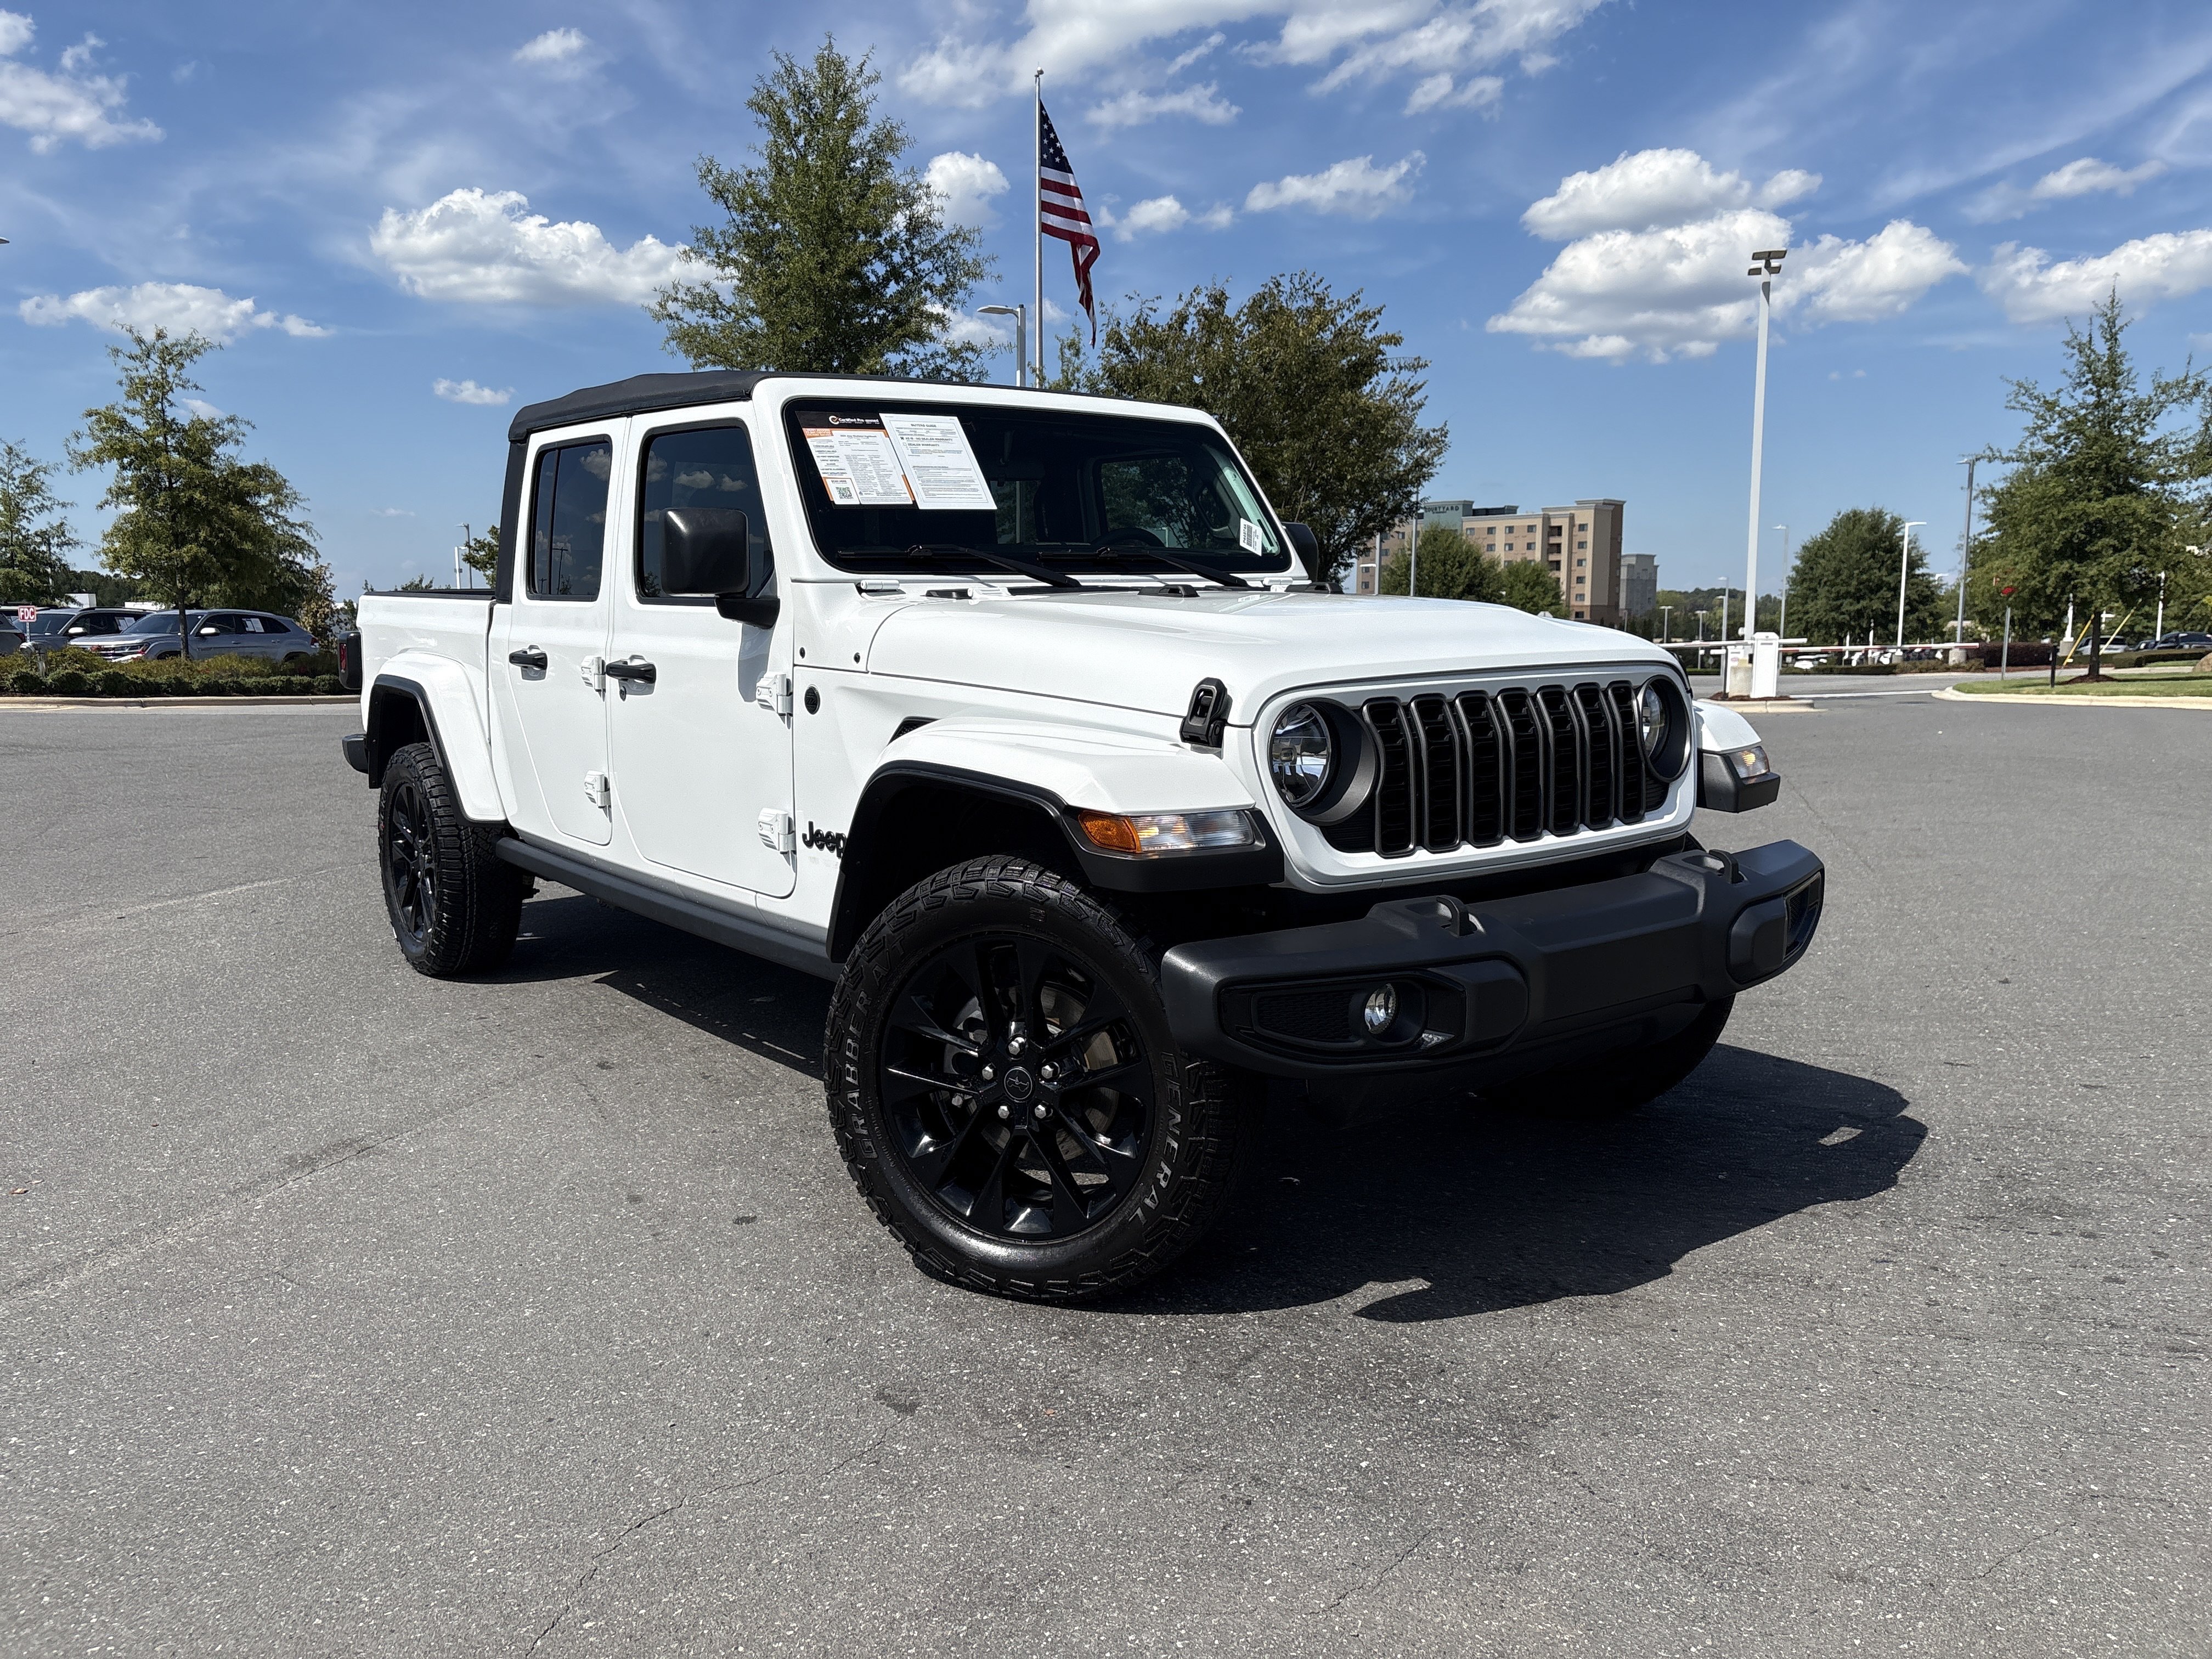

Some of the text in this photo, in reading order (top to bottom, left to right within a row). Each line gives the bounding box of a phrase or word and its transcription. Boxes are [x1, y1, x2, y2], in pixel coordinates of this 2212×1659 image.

[20, 608, 34, 619] FDC
[802, 821, 847, 859] Jeep
[845, 990, 878, 1159] GRABBER
[872, 934, 906, 987] A/T
[1128, 1052, 1182, 1226] GENERAL
